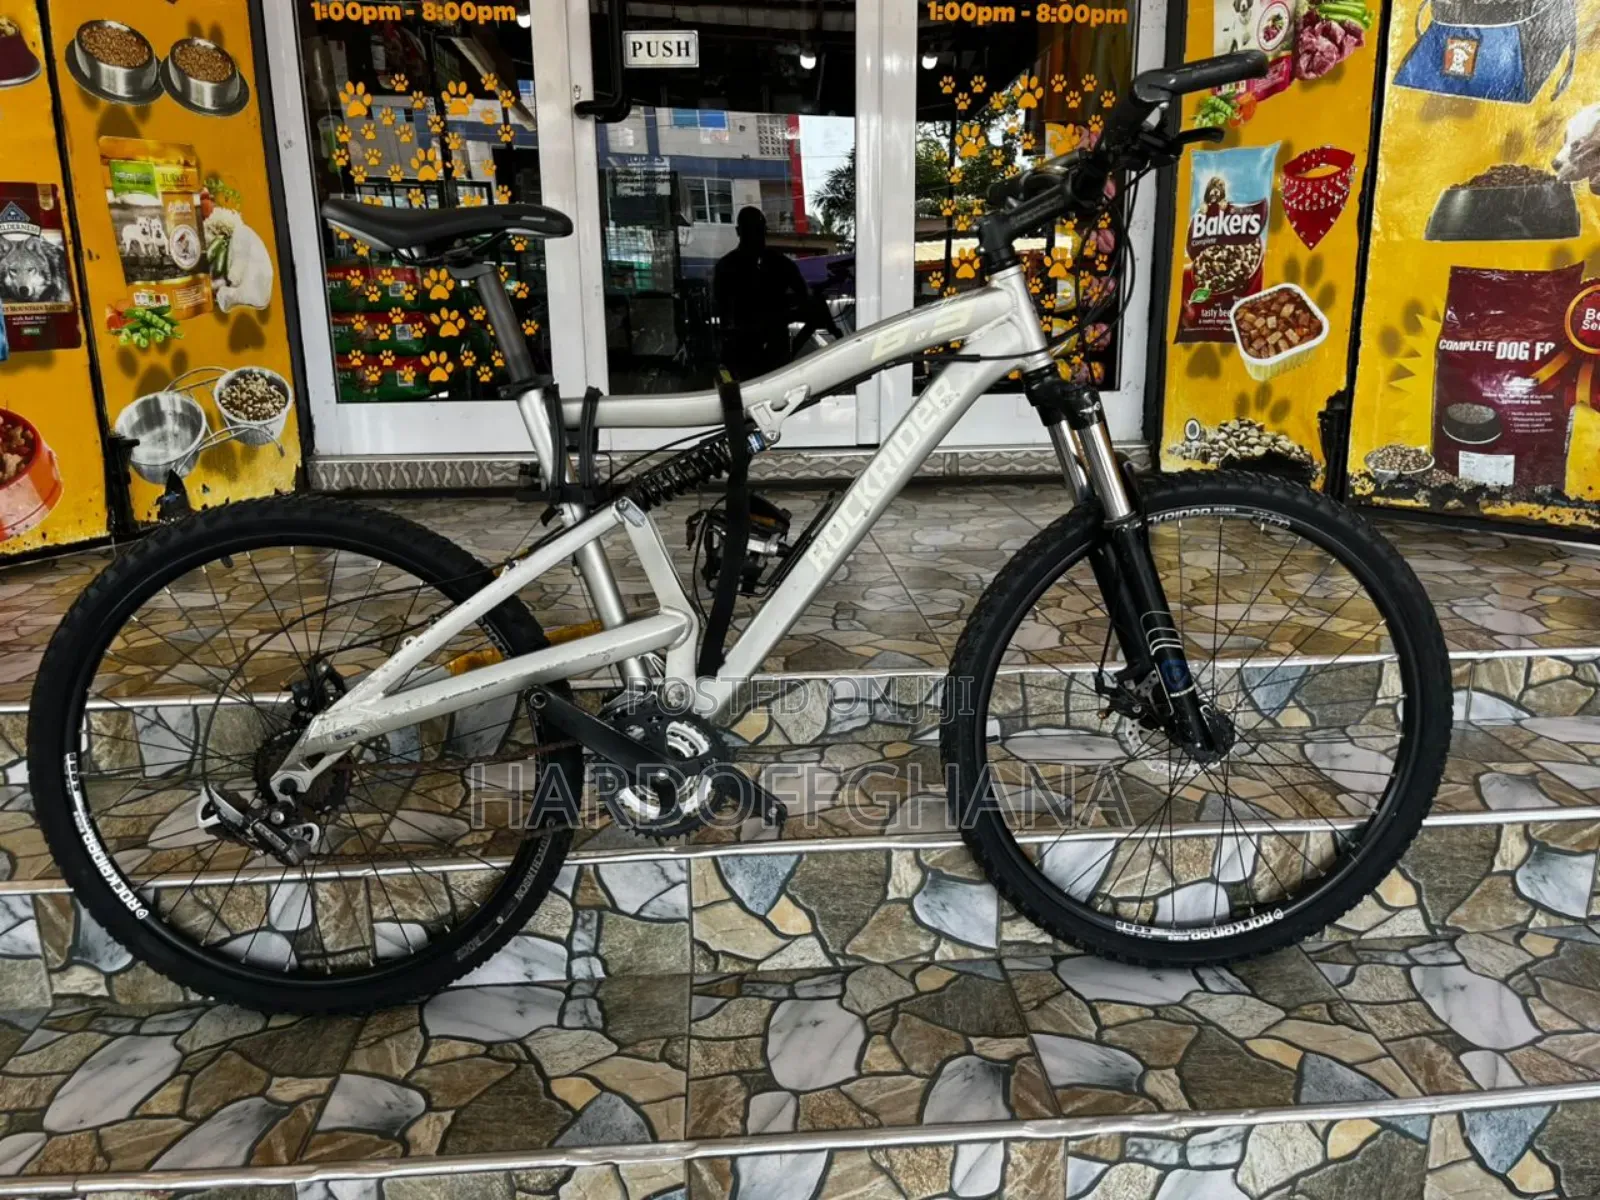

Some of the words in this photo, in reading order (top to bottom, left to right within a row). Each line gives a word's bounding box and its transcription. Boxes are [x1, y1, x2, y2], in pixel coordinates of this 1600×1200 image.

[311, 2, 400, 25] 1:00pm
[422, 3, 516, 25] 8:00pm
[927, 1, 1015, 26] 1:00pm
[1036, 4, 1128, 28] 8:00pm
[632, 40, 690, 58] PUSH
[1192, 211, 1260, 238] Bakers
[1439, 339, 1495, 352] COMPLETE
[1496, 342, 1530, 360] DOG
[806, 376, 955, 573] ROCKRIDER
[1190, 911, 1275, 940] ROCKRIDER
